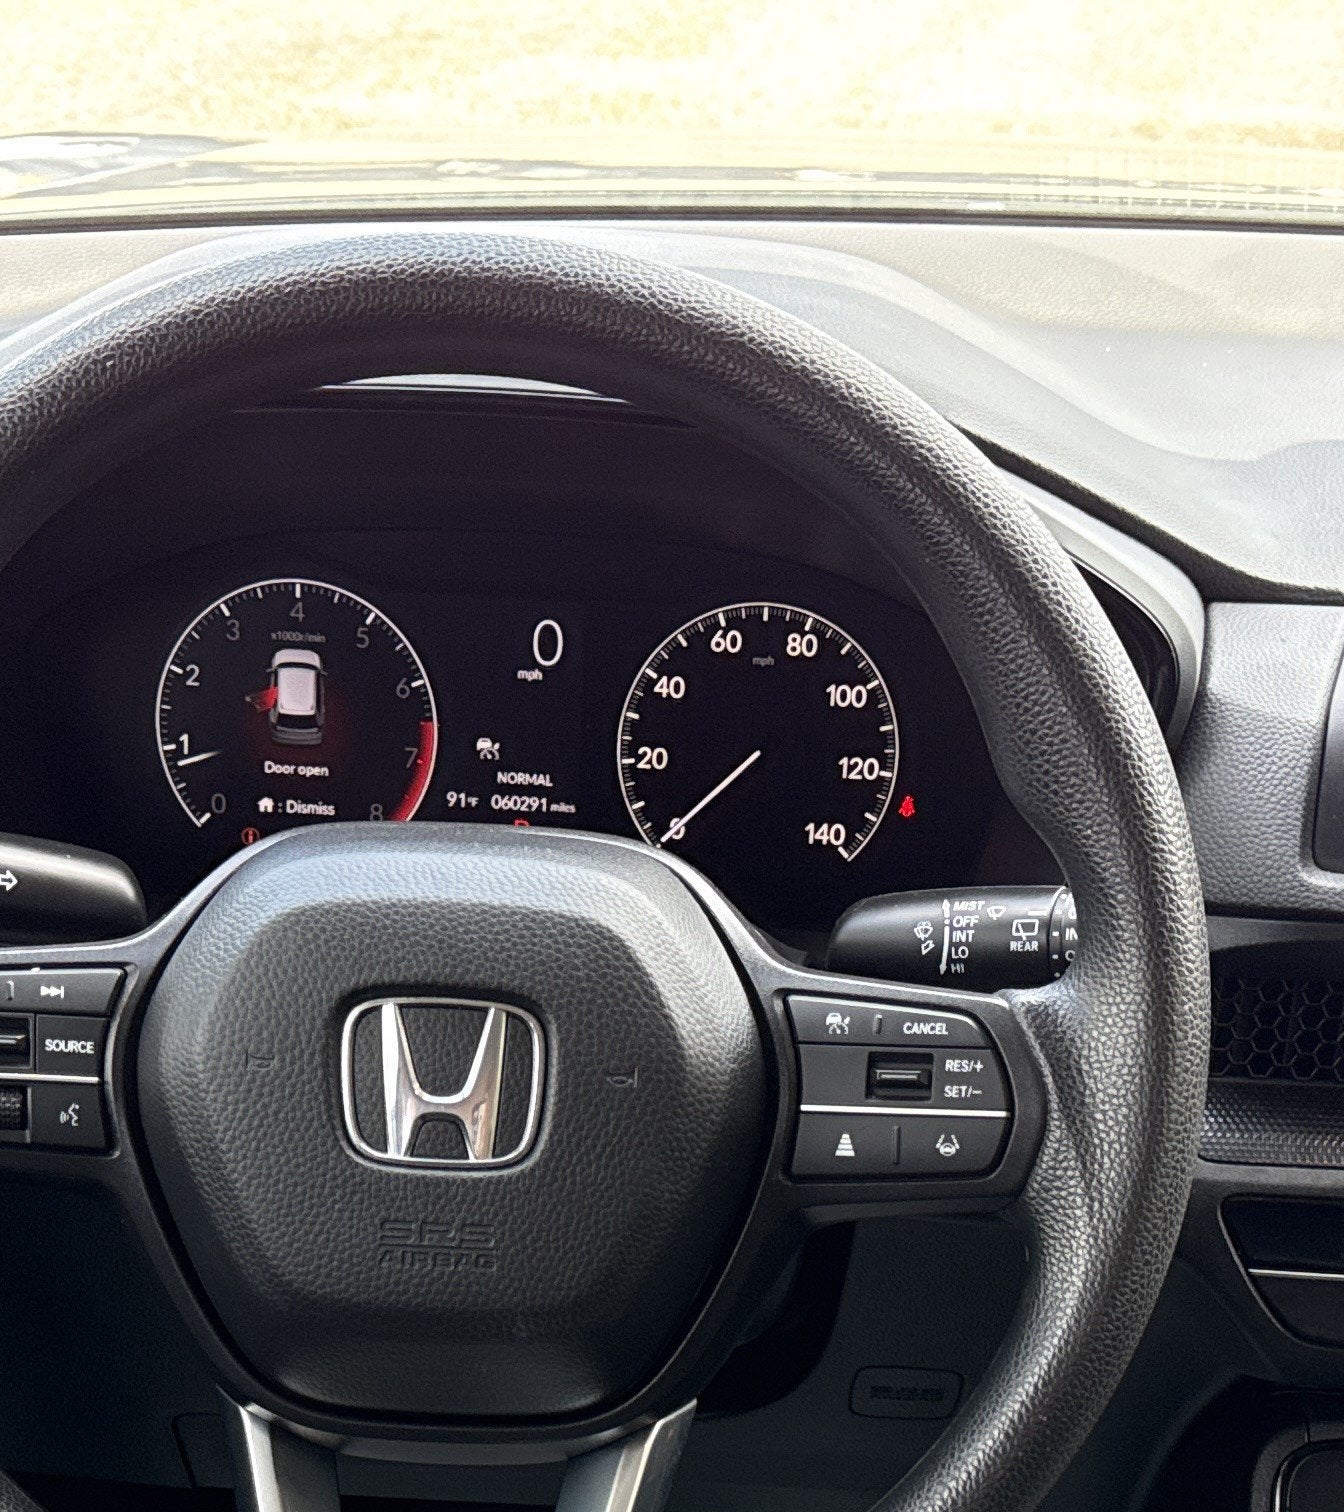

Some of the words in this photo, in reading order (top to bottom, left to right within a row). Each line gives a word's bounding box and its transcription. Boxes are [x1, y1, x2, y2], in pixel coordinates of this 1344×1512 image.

[290, 602, 304, 622] 4
[226, 620, 240, 641] 3
[357, 628, 370, 648] 5
[533, 619, 564, 667] 0
[710, 630, 743, 654] 60
[786, 632, 818, 657] 80
[752, 655, 775, 668] mph
[186, 664, 200, 687] 2
[517, 669, 543, 682] mph
[396, 677, 410, 699] 6
[654, 675, 686, 699] 40
[826, 684, 867, 708] 100
[179, 733, 189, 755] 1
[405, 748, 418, 768] 7
[636, 746, 668, 770] 20
[264, 760, 296, 776] Door
[298, 763, 329, 778] open
[838, 757, 880, 781] 120
[497, 771, 553, 788] NORMAL
[211, 794, 226, 814] 0
[285, 800, 336, 817] Dismiss
[490, 794, 547, 812] 060291
[550, 801, 576, 814] miles
[805, 822, 846, 847] 140
[952, 900, 986, 912] MIST
[951, 915, 980, 928] OFF
[951, 929, 975, 943] INT
[1009, 940, 1039, 952] REAR
[951, 946, 969, 959] LO
[950, 963, 965, 974] HI
[903, 1021, 949, 1036] CANCEL
[44, 1039, 95, 1055] SOURCE
[944, 1059, 984, 1073] RES/+
[379, 1219, 496, 1248] SRS
